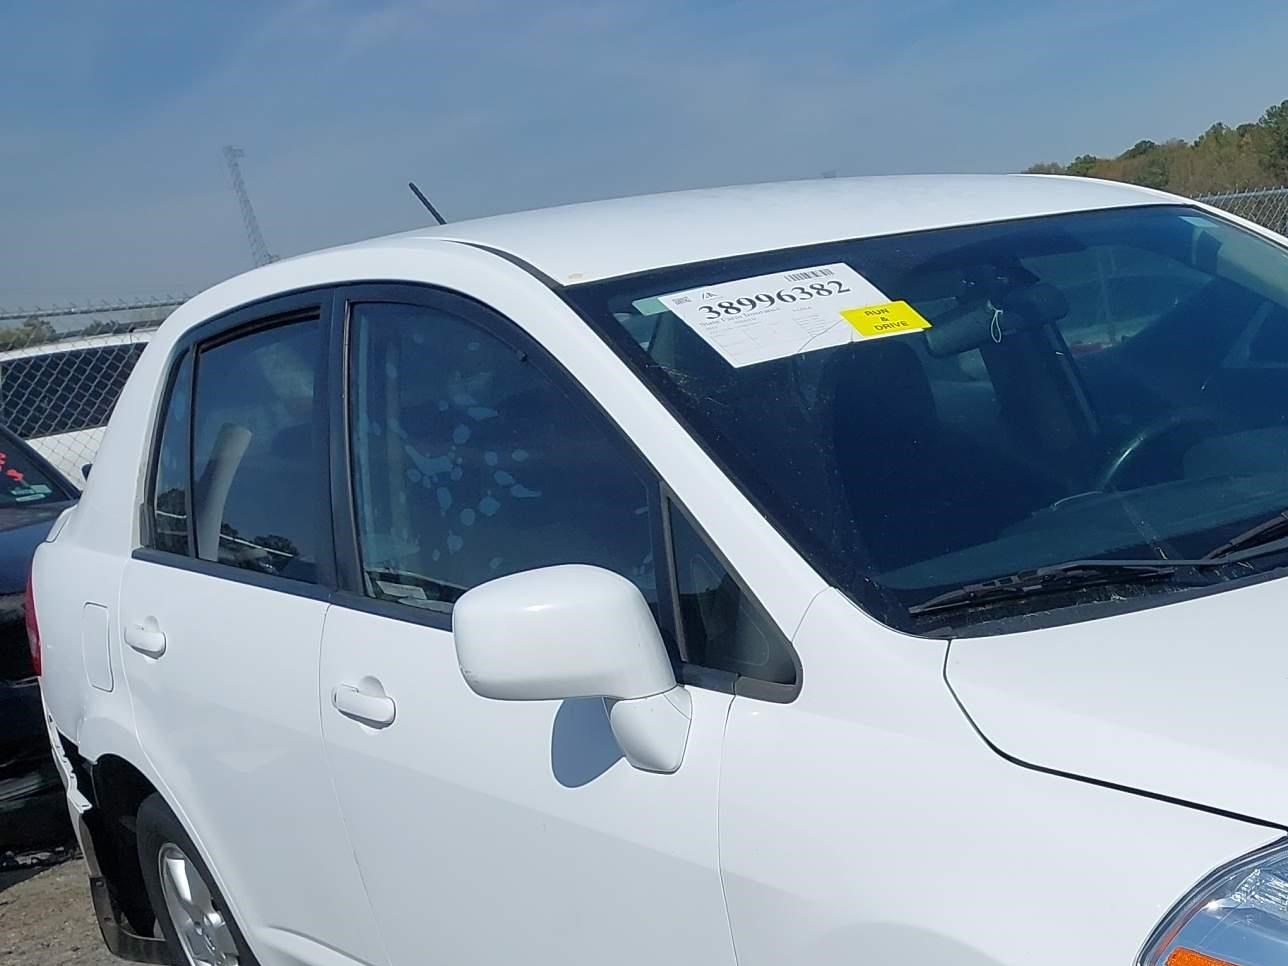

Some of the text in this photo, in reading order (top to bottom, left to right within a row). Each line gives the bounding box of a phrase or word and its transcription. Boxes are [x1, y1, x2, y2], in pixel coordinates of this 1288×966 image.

[698, 280, 851, 320] 38996382
[864, 308, 890, 316] RUN
[874, 321, 909, 331] DRIVE
